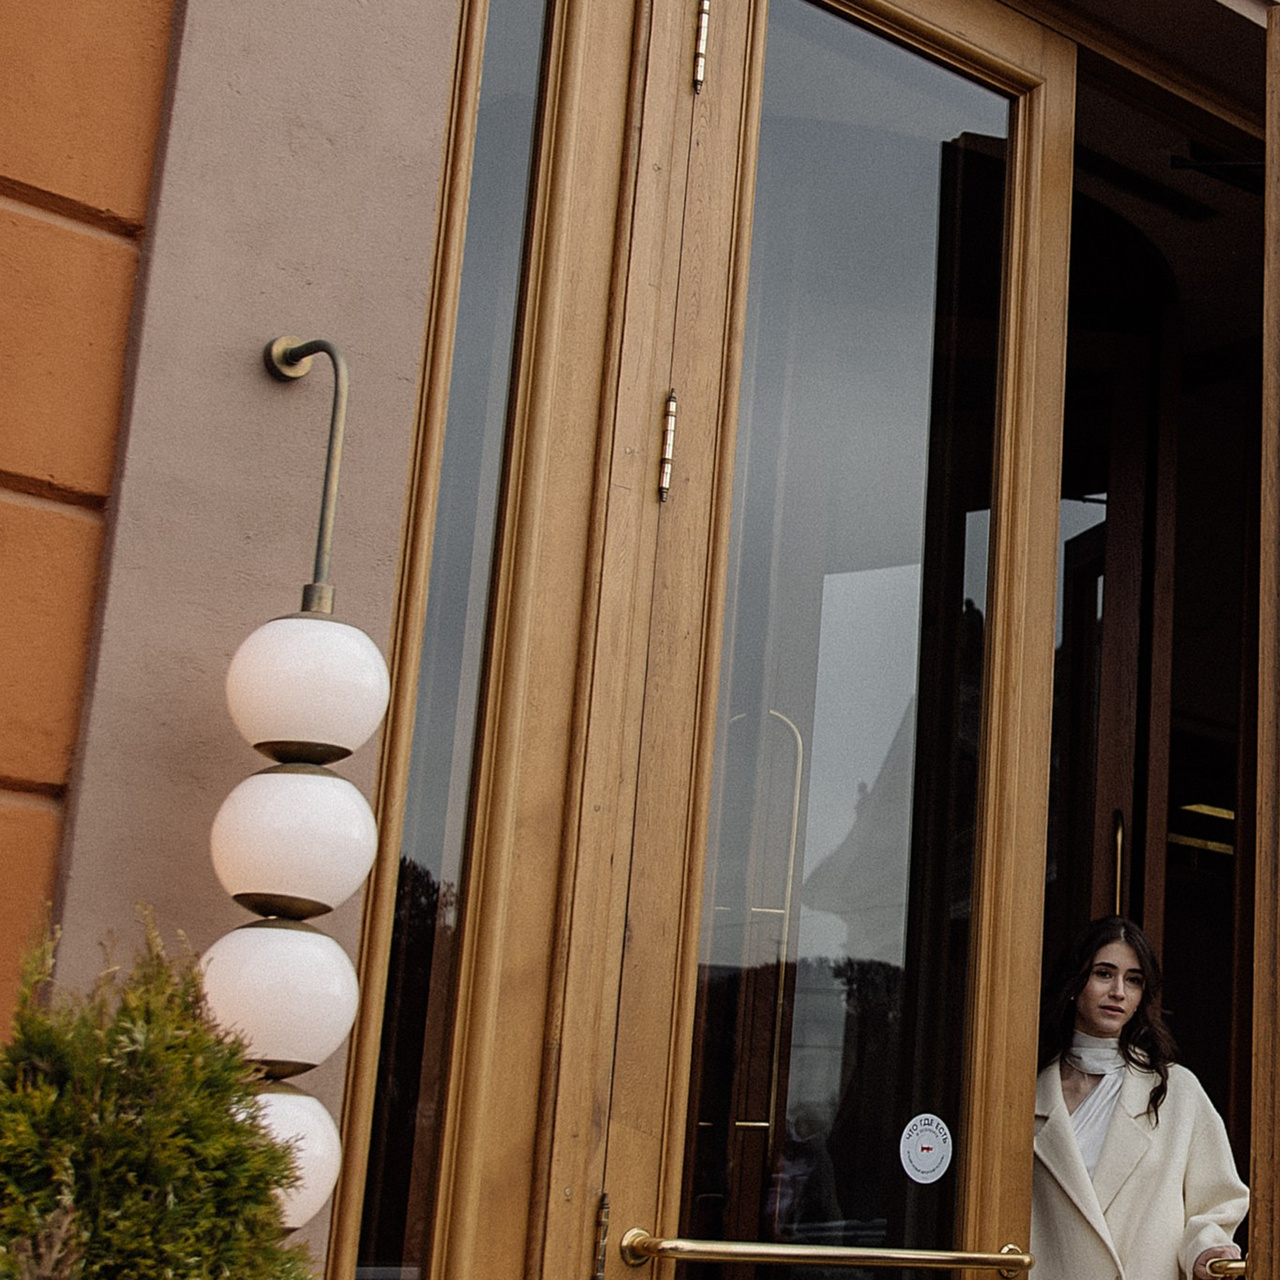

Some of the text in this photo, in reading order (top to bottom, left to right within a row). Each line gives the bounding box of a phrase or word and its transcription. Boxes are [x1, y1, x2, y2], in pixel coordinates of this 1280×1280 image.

[906, 1123, 918, 1140] ЧТО
[920, 1118, 934, 1126] ГДЕ
[935, 1122, 948, 1144] ЕСТЬ
